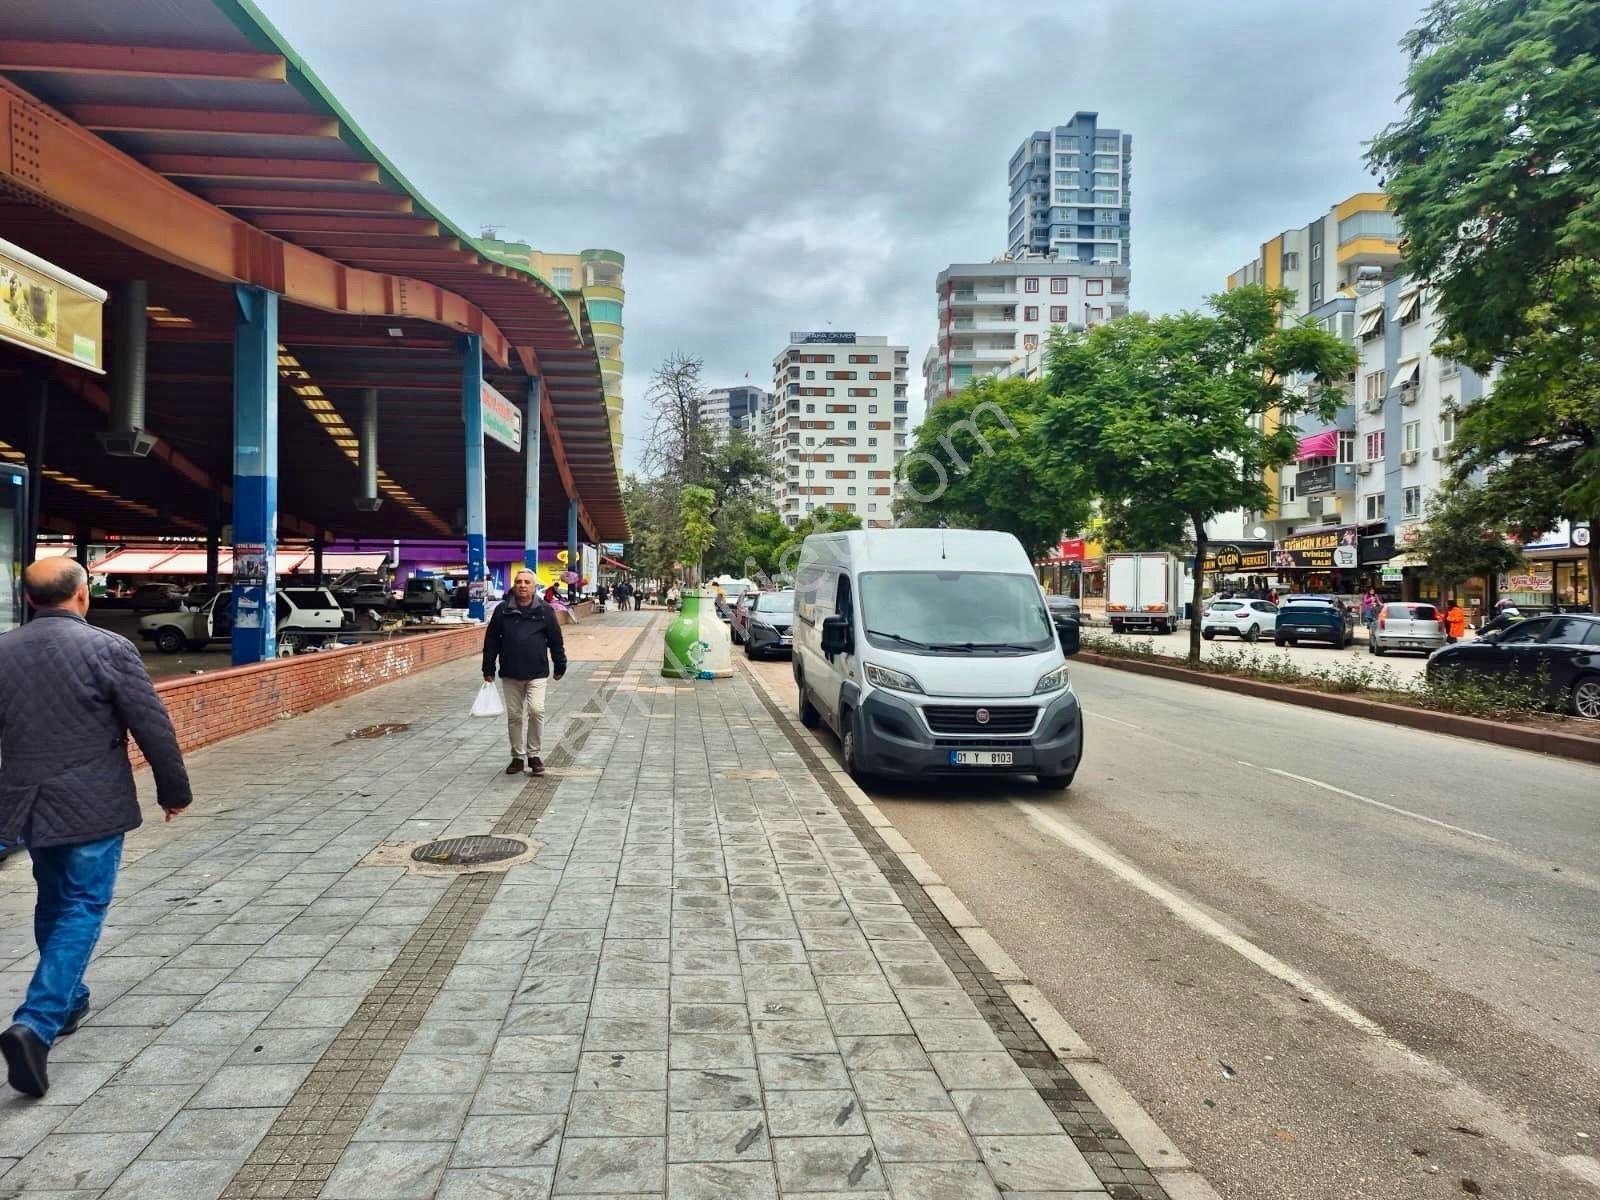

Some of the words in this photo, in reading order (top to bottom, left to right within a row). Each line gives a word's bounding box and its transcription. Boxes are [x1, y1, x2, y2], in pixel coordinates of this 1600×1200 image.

[957, 752, 967, 762] 01
[974, 752, 980, 763] Y
[991, 752, 1012, 763] 8103
